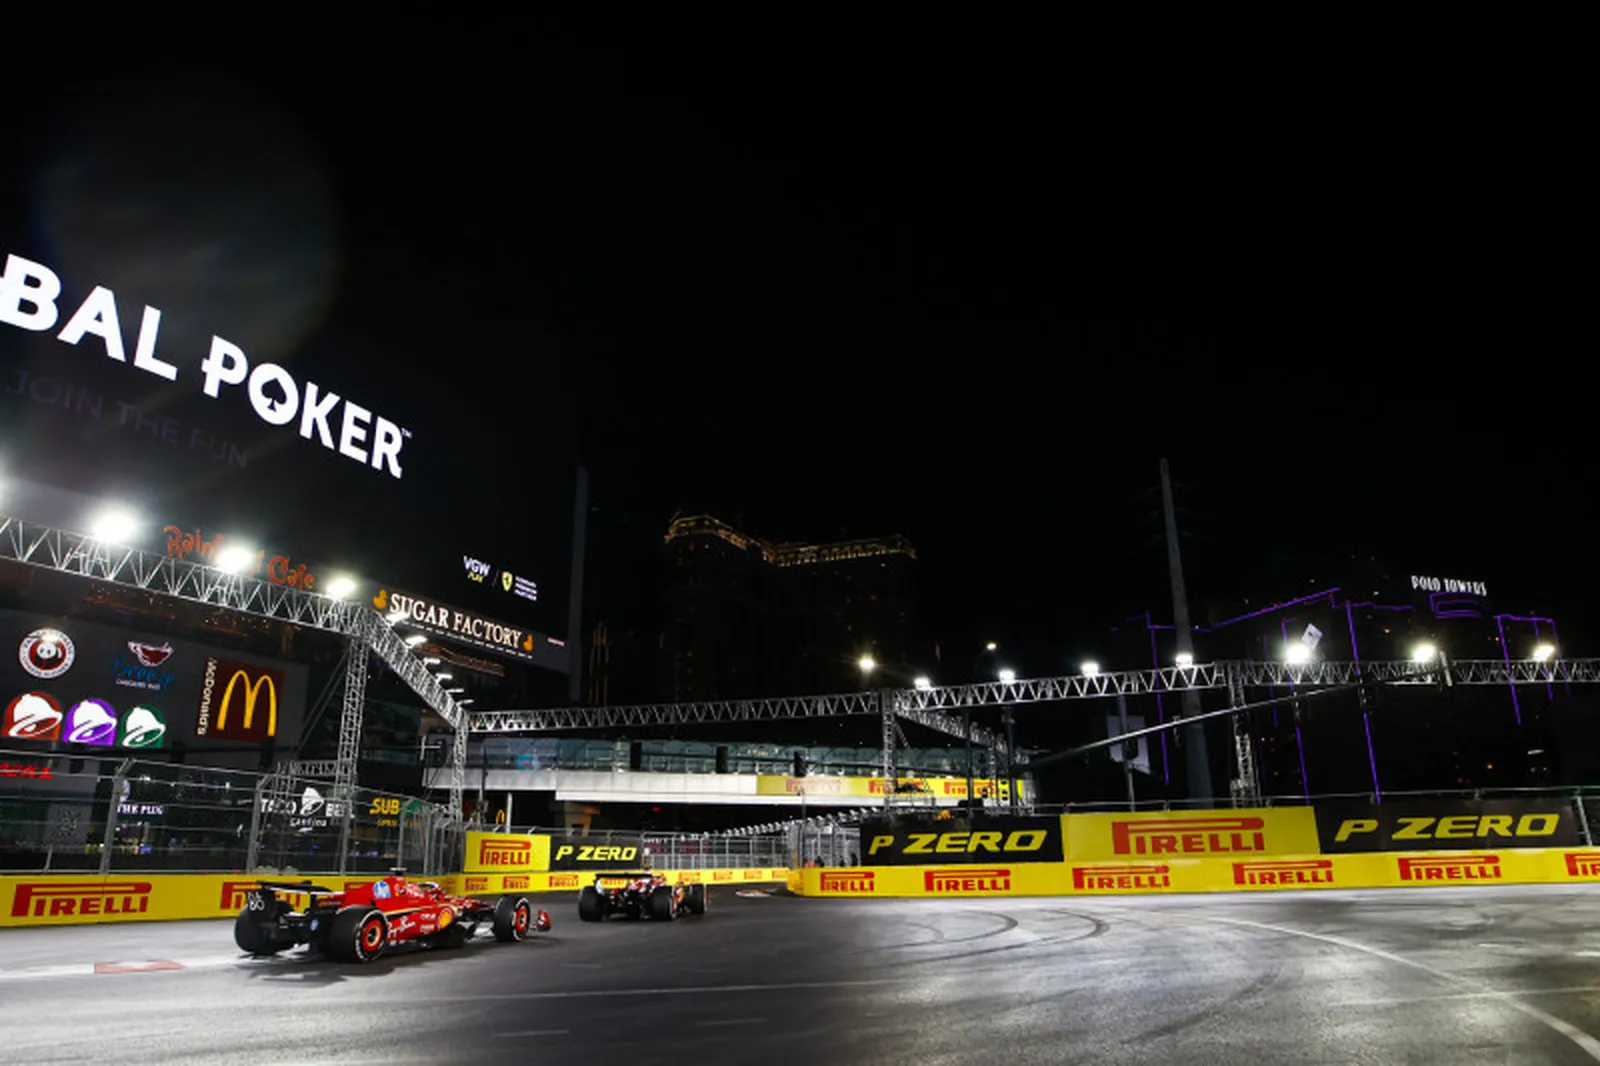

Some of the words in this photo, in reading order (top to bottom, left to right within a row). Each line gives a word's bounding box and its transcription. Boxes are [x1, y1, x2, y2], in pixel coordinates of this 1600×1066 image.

[4, 369, 101, 420] JOIN
[116, 400, 180, 447] THE
[189, 429, 249, 469] FUN
[463, 555, 491, 576] VGW
[389, 593, 450, 629] SUGAR
[453, 611, 522, 650] FACTORY
[1111, 817, 1265, 856] PIRELLI
[1335, 818, 1379, 843] P
[1392, 813, 1561, 839] ZERO
[480, 839, 531, 866] PIRELLI
[555, 846, 574, 861] P
[576, 846, 637, 862] ZERO
[868, 835, 895, 855] P
[902, 830, 1048, 854] ZERO
[924, 869, 1011, 892] PIRELLI
[1073, 865, 1171, 890] PIRELLI
[1233, 860, 1333, 885] PIRELLI
[1398, 855, 1502, 881] PIRELLI
[820, 871, 875, 892] PIRELLI
[11, 882, 153, 917] PIRELLI
